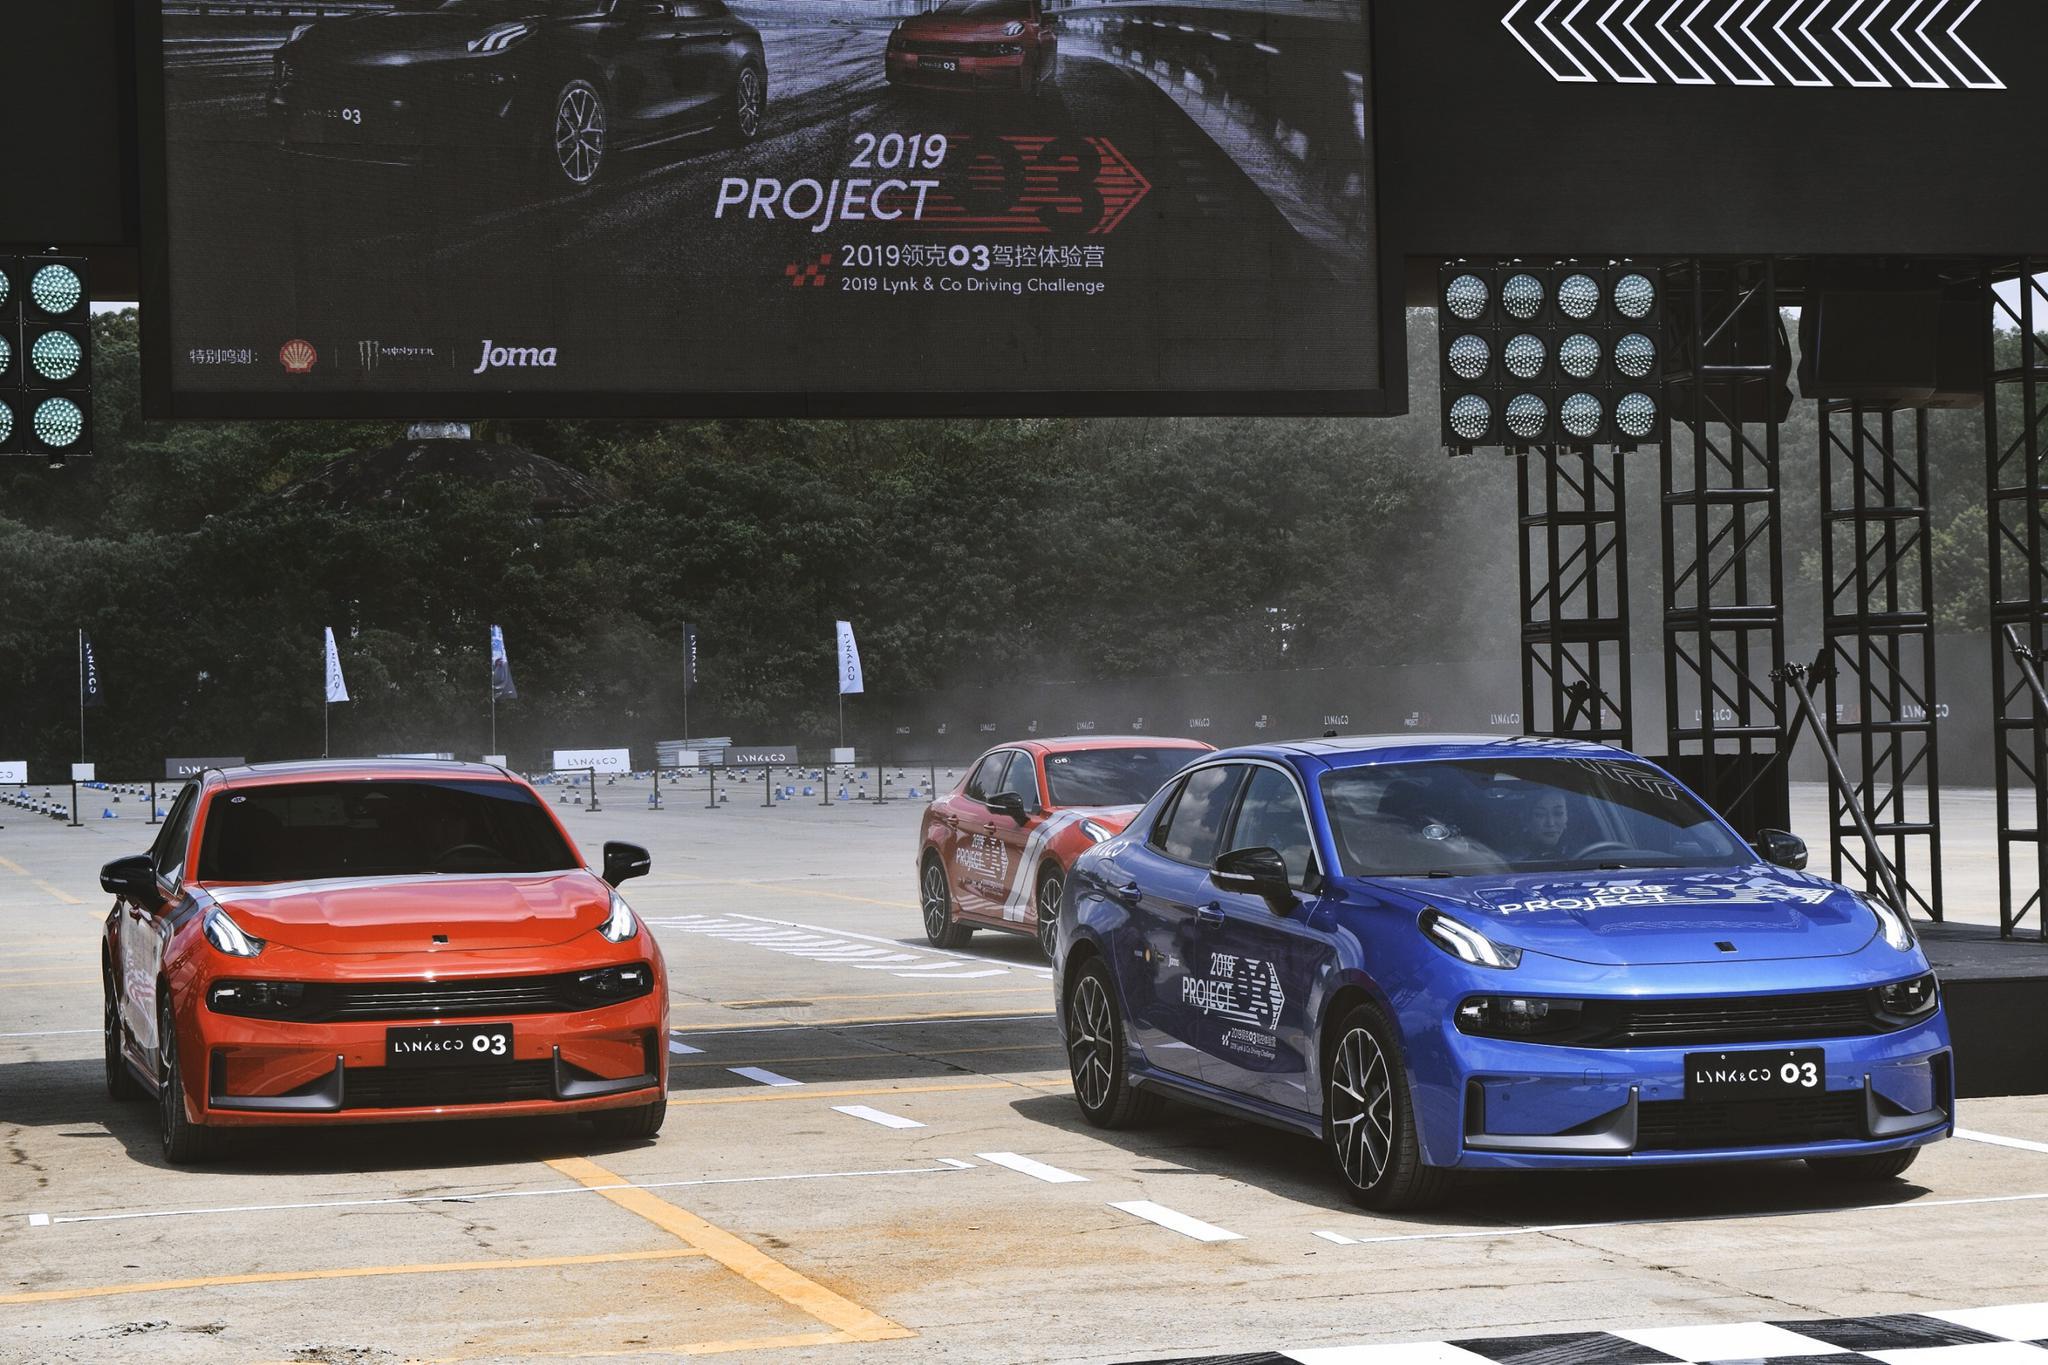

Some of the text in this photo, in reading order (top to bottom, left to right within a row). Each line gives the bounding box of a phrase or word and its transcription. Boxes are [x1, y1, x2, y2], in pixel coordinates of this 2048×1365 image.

[342, 108, 361, 124] 03
[850, 132, 947, 169] 2019
[714, 177, 940, 232] PROJECT
[842, 276, 1105, 295] 2019 Lynk & Co Driving Challenge
[473, 339, 558, 374] Joma
[568, 757, 618, 767] LYNK&CO
[737, 753, 786, 763] LYNK&CO
[1588, 884, 1663, 896] 2019
[1498, 892, 1668, 916] PROJECT
[1210, 952, 1234, 977] 2019
[1182, 976, 1233, 1015] PROJECT
[394, 1034, 507, 1056] LYNK&CO 03
[1696, 1062, 1818, 1088] LYNK&CO 03
